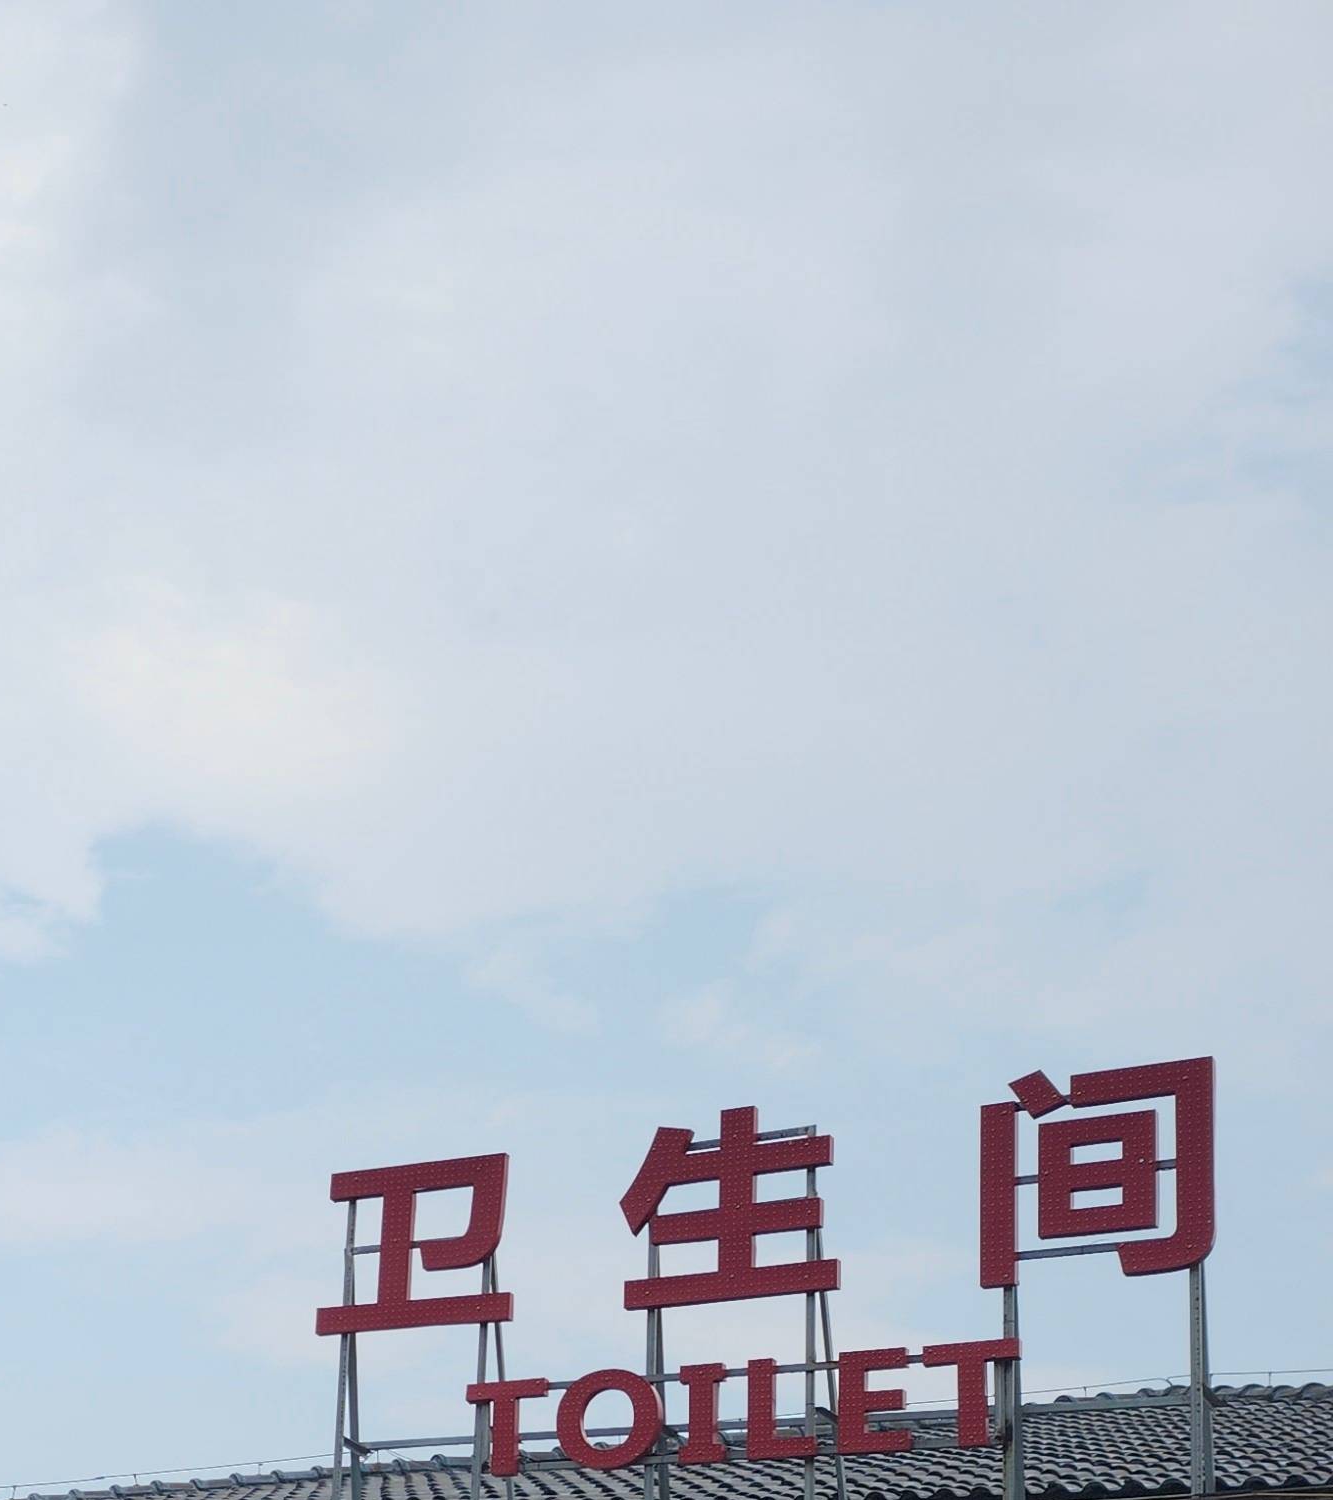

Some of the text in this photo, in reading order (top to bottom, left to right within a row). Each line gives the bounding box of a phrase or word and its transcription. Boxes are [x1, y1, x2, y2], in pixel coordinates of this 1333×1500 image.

[315, 1056, 1216, 1337] 卫生间
[465, 1337, 1023, 1478] TOILET
